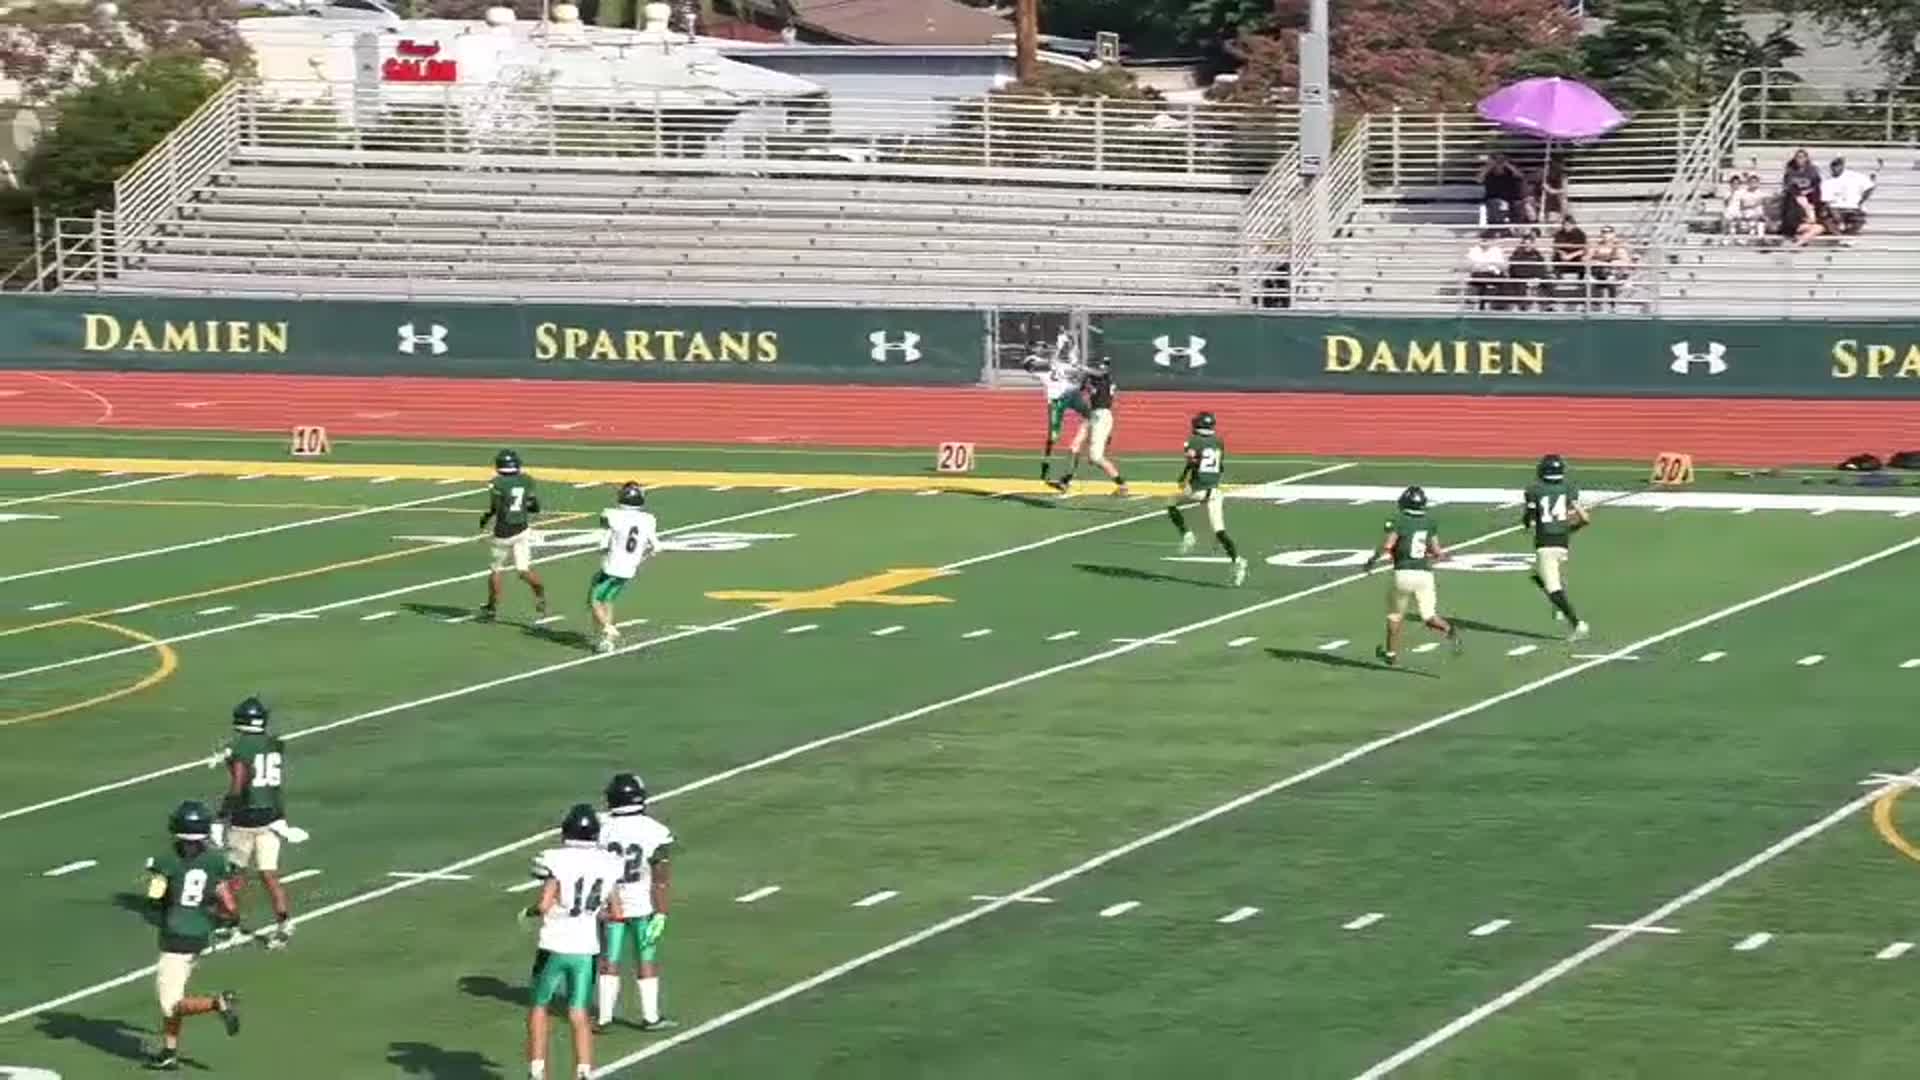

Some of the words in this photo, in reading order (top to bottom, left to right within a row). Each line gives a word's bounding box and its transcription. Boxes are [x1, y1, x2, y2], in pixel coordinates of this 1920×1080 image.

[82, 313, 288, 353] DAMIEN
[535, 322, 777, 362] SPARTANS
[1324, 335, 1545, 375] DAMIEN
[295, 428, 320, 453] 10
[940, 444, 967, 469] 20
[1200, 447, 1221, 473] 21
[1654, 456, 1681, 482] 30
[1540, 493, 1567, 523] 14
[625, 525, 639, 554] 6
[1409, 529, 1428, 559] 6
[252, 752, 282, 787] 16
[180, 868, 208, 906] 8
